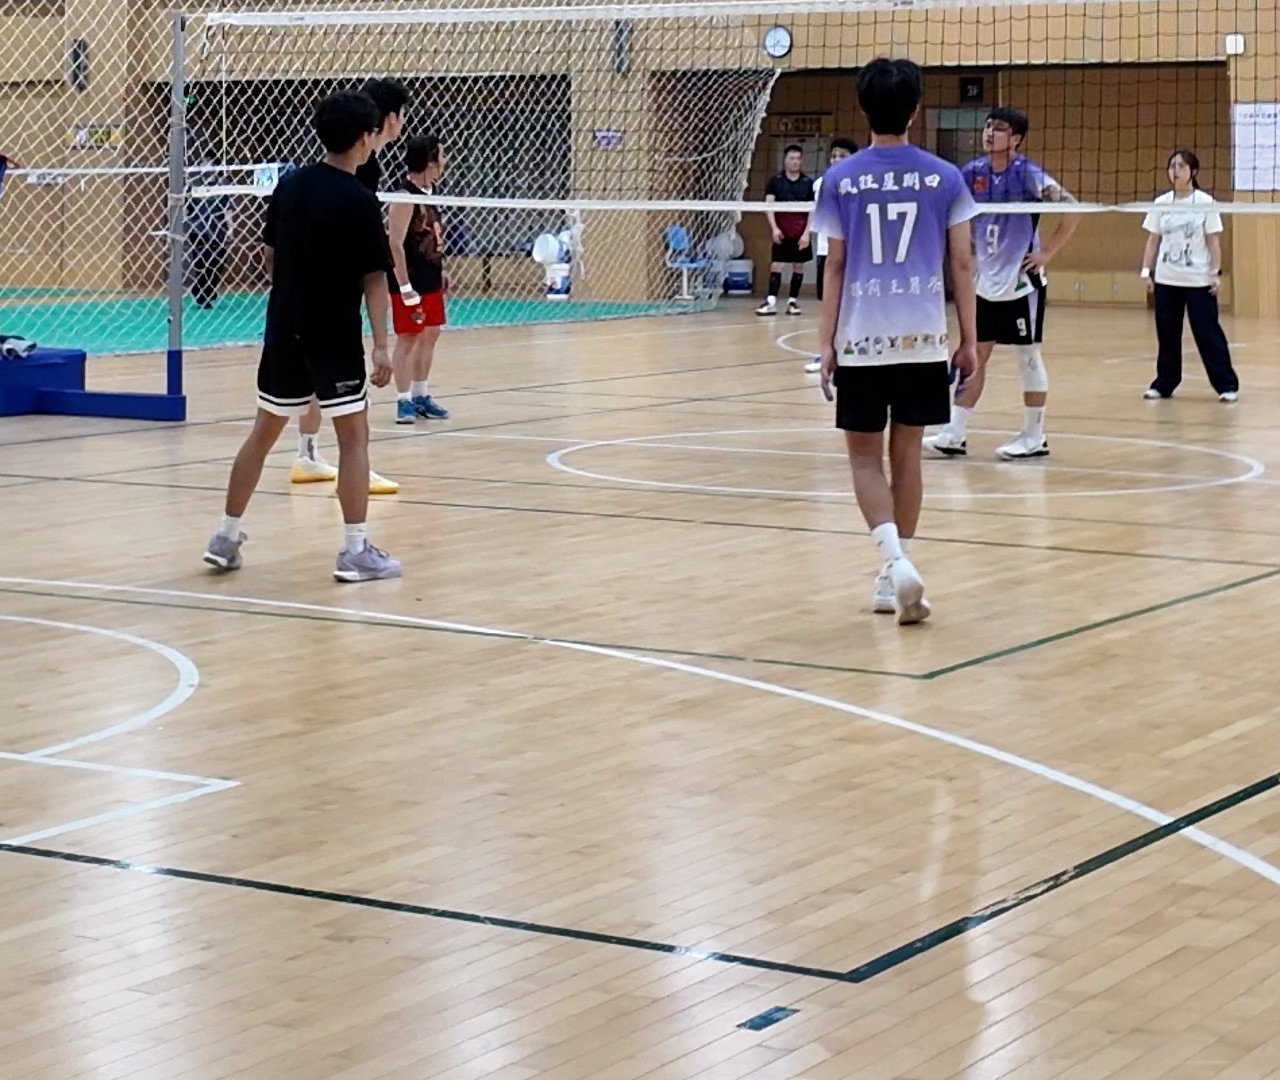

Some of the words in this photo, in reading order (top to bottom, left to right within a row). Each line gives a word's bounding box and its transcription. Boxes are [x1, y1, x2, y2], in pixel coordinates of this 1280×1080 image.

[865, 201, 918, 265] 17
[986, 223, 999, 255] 9
[1016, 317, 1028, 337] 9
